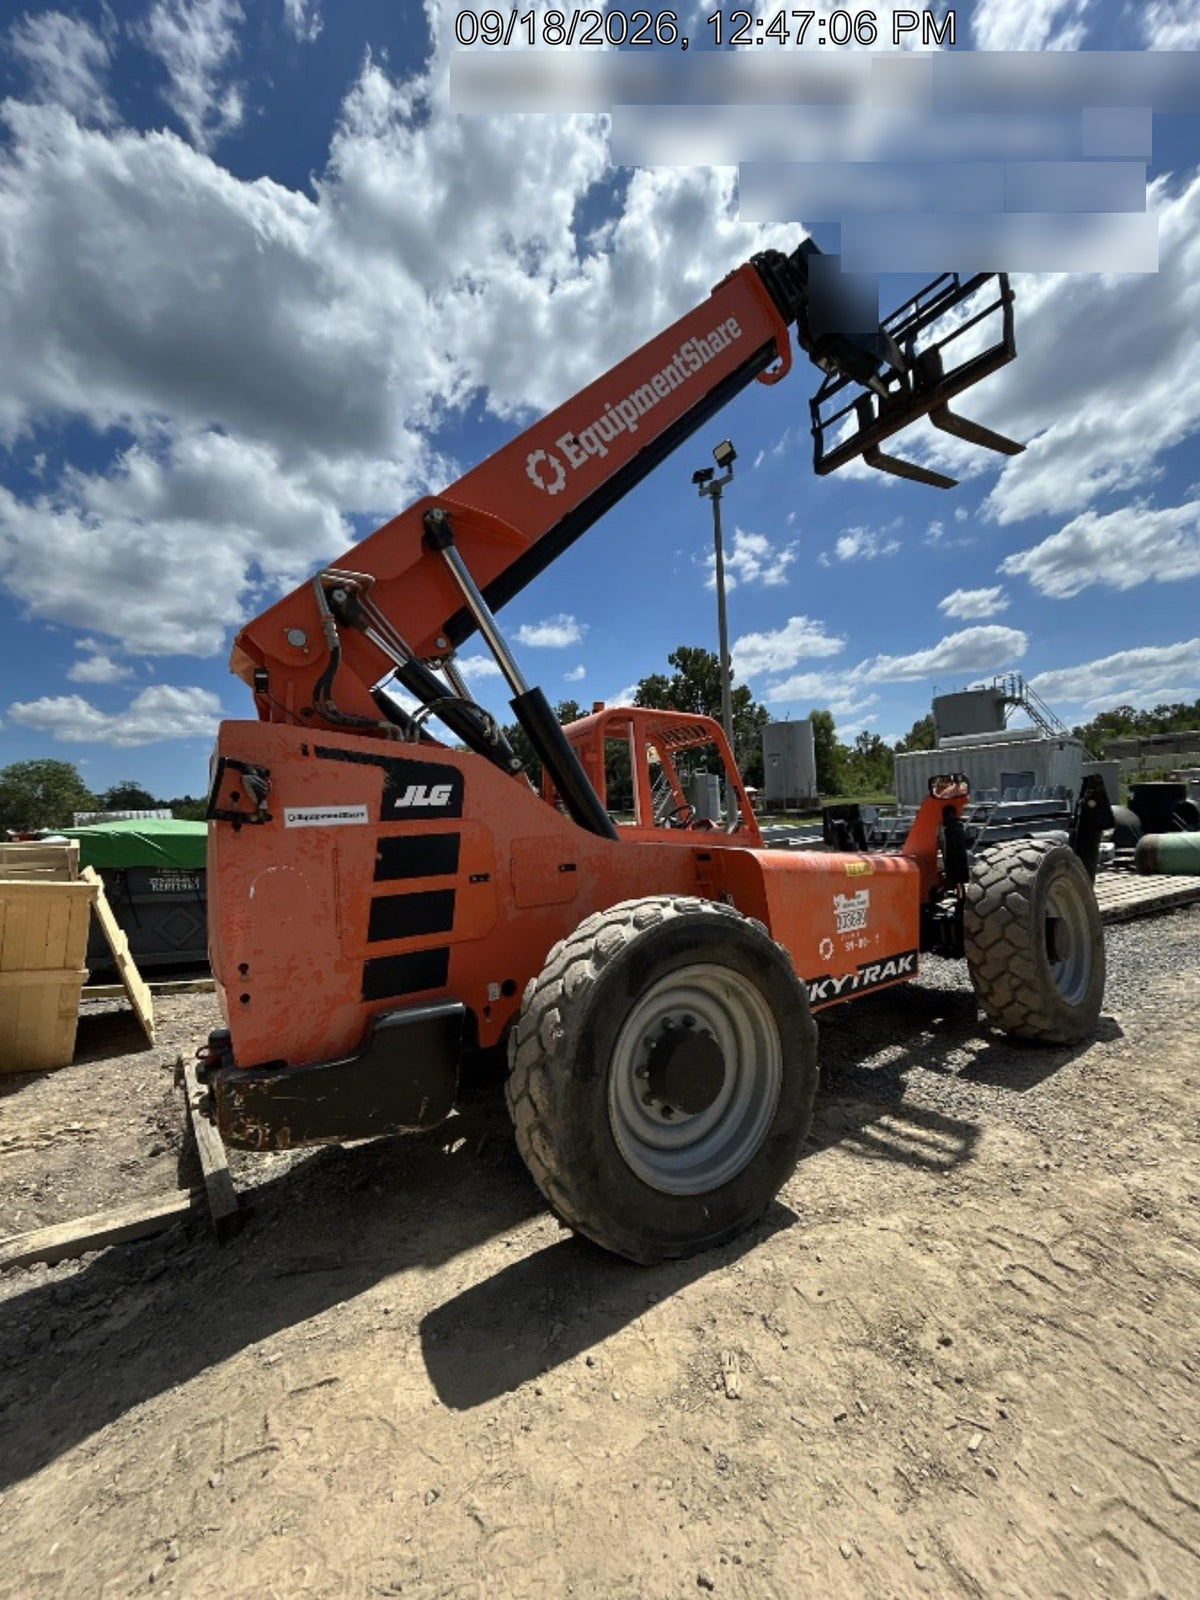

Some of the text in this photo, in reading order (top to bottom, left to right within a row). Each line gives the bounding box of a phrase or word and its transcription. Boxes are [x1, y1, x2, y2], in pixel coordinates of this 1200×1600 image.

[556, 316, 742, 469] EquipmentShare
[394, 784, 453, 807] JLG
[805, 953, 915, 1002] KYTRAK
